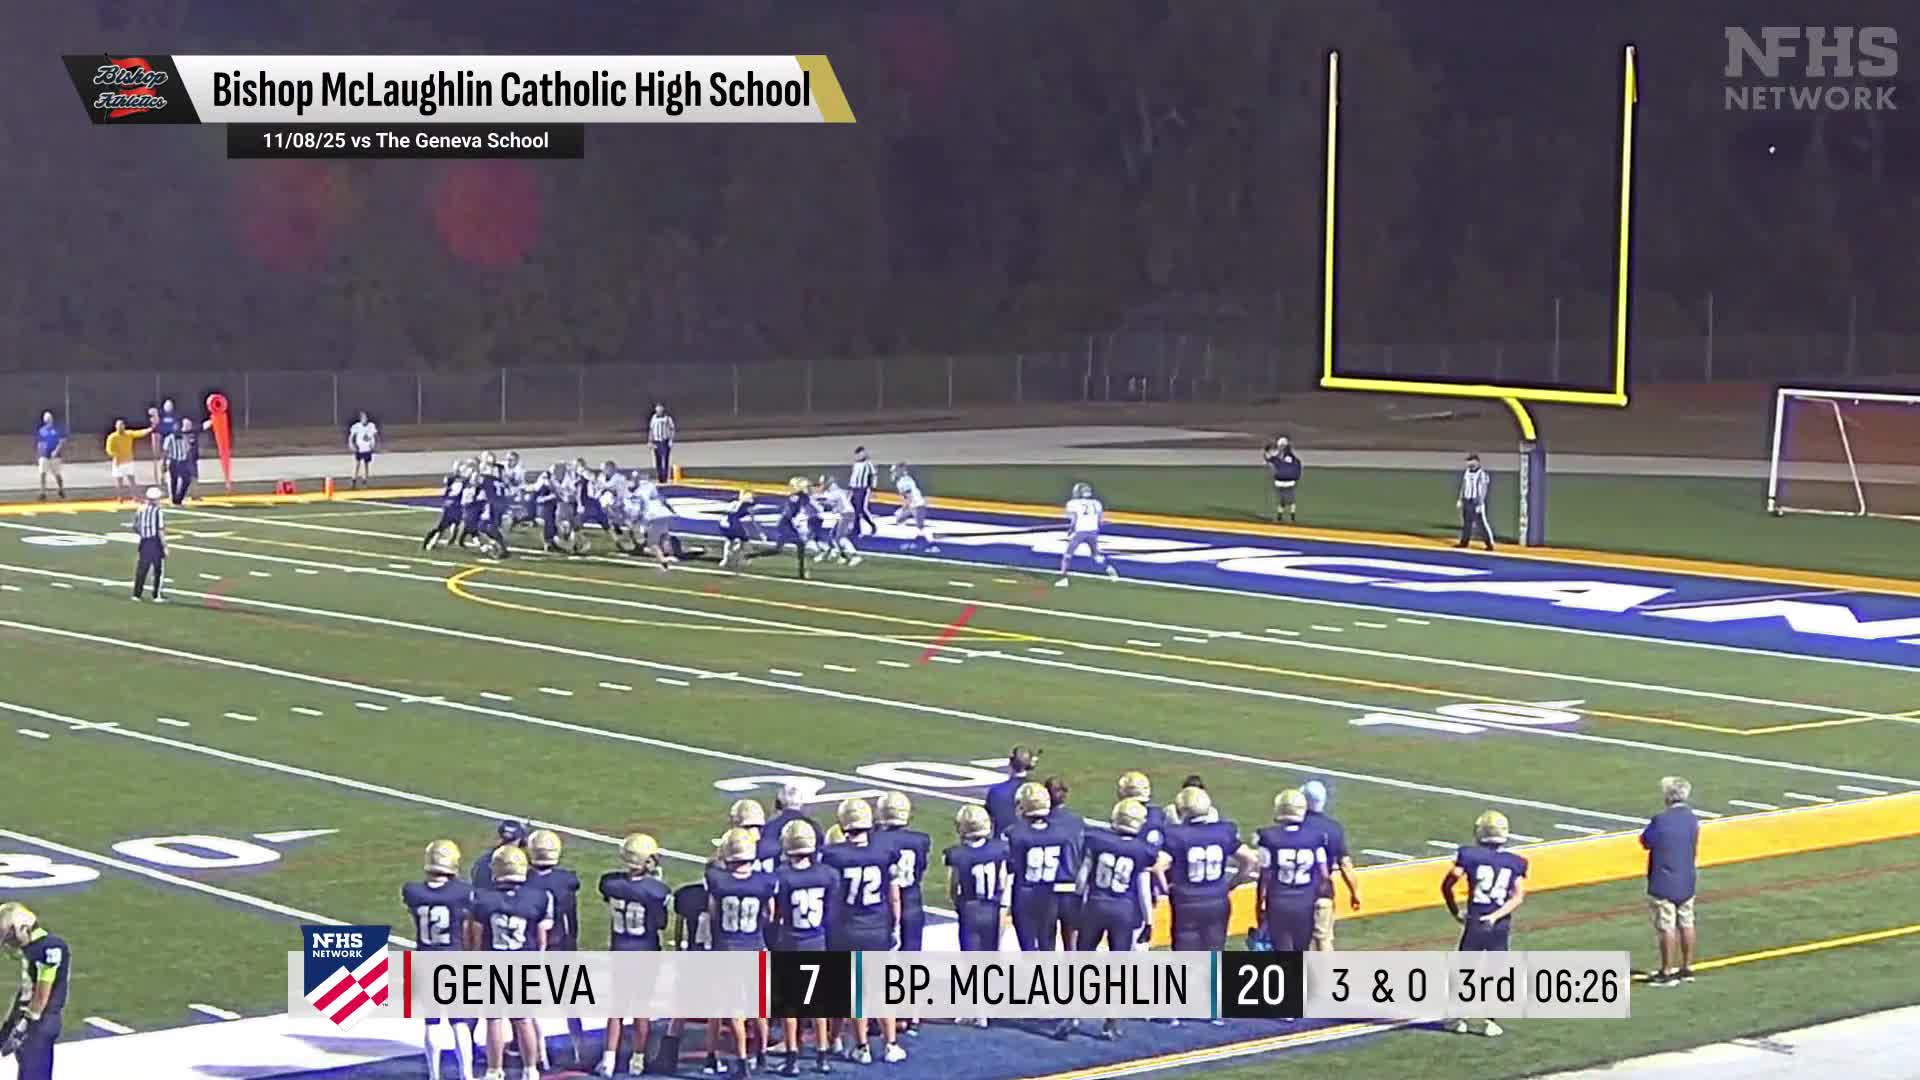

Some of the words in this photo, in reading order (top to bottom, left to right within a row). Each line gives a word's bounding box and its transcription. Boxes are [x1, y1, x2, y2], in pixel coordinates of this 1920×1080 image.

[843, 865, 881, 906] 72
[1277, 848, 1314, 885] 52
[1472, 865, 1512, 906] 24
[416, 905, 450, 945] 12
[791, 887, 825, 929] 25
